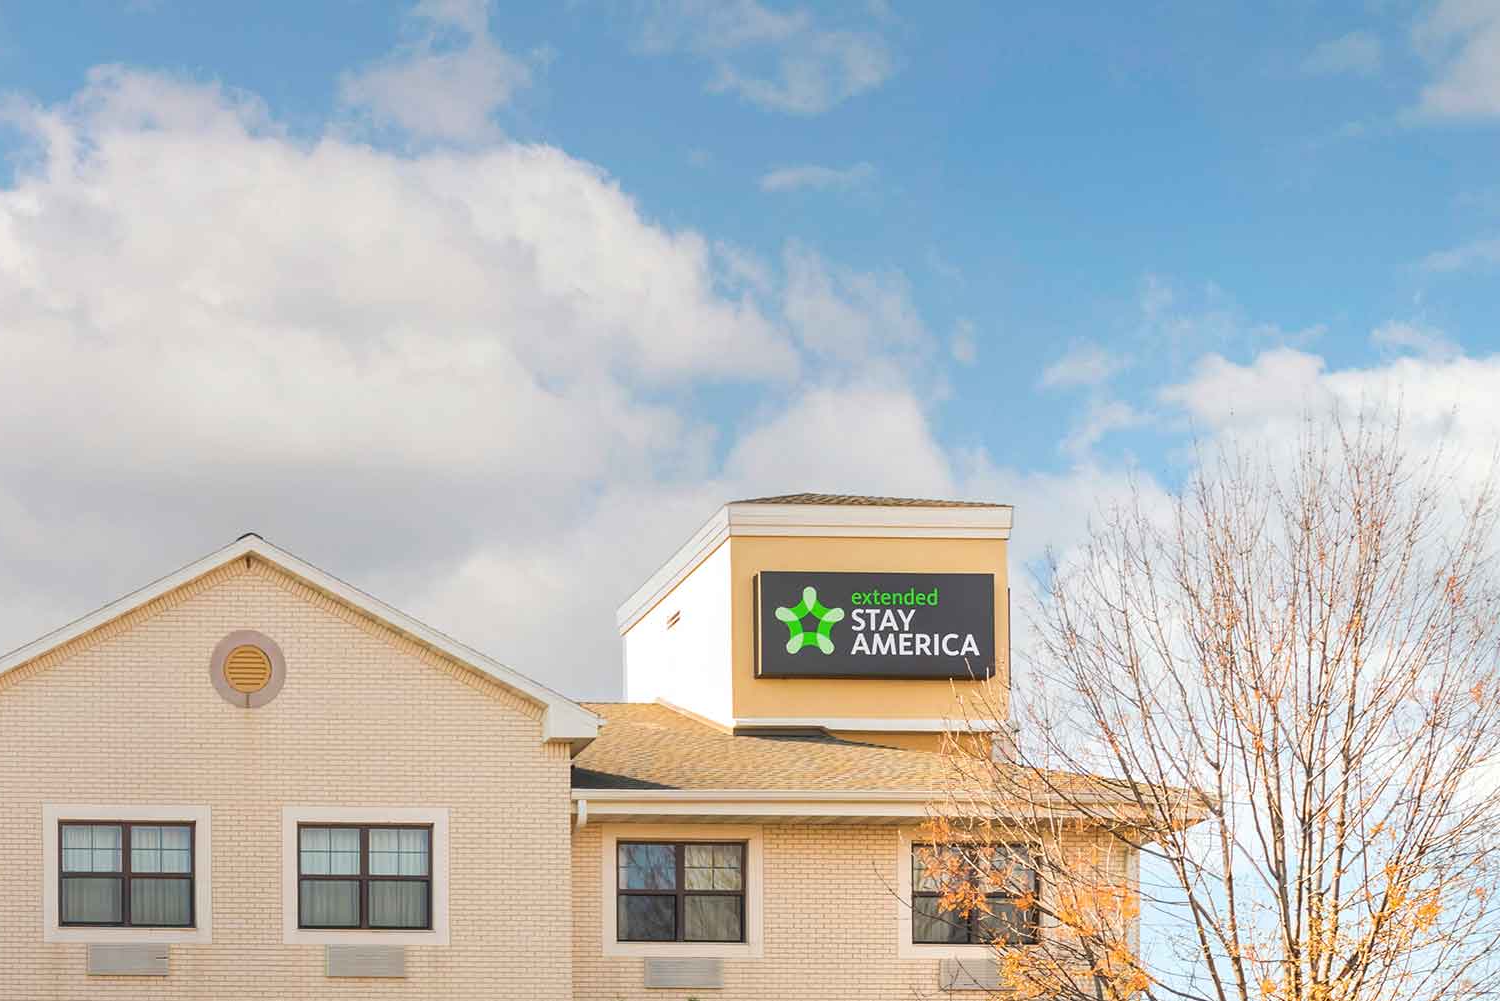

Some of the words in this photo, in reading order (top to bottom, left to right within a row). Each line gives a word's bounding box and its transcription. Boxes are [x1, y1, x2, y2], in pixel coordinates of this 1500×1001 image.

[851, 588, 939, 606] extended
[851, 609, 916, 631] STAY
[850, 633, 980, 656] AMERICA
